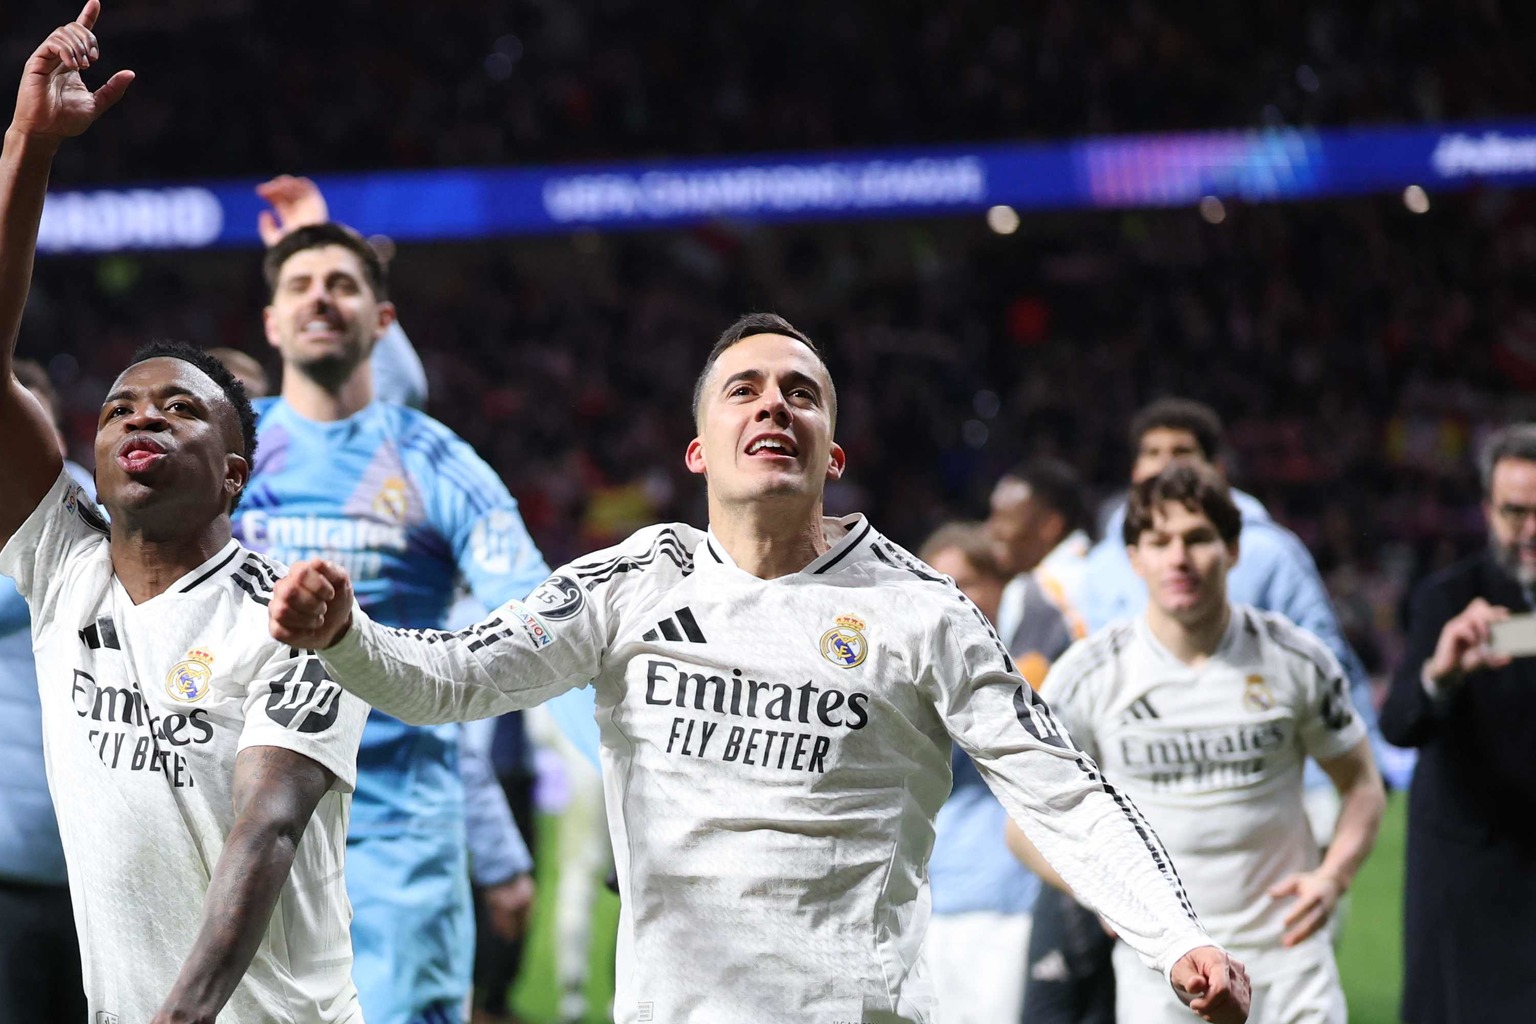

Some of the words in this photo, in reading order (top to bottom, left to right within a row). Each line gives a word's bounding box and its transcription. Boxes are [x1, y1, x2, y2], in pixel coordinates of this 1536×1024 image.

[536, 590, 558, 604] 15
[645, 660, 869, 731] Emirates
[666, 717, 717, 759] FLY
[723, 725, 831, 773] BETTER
